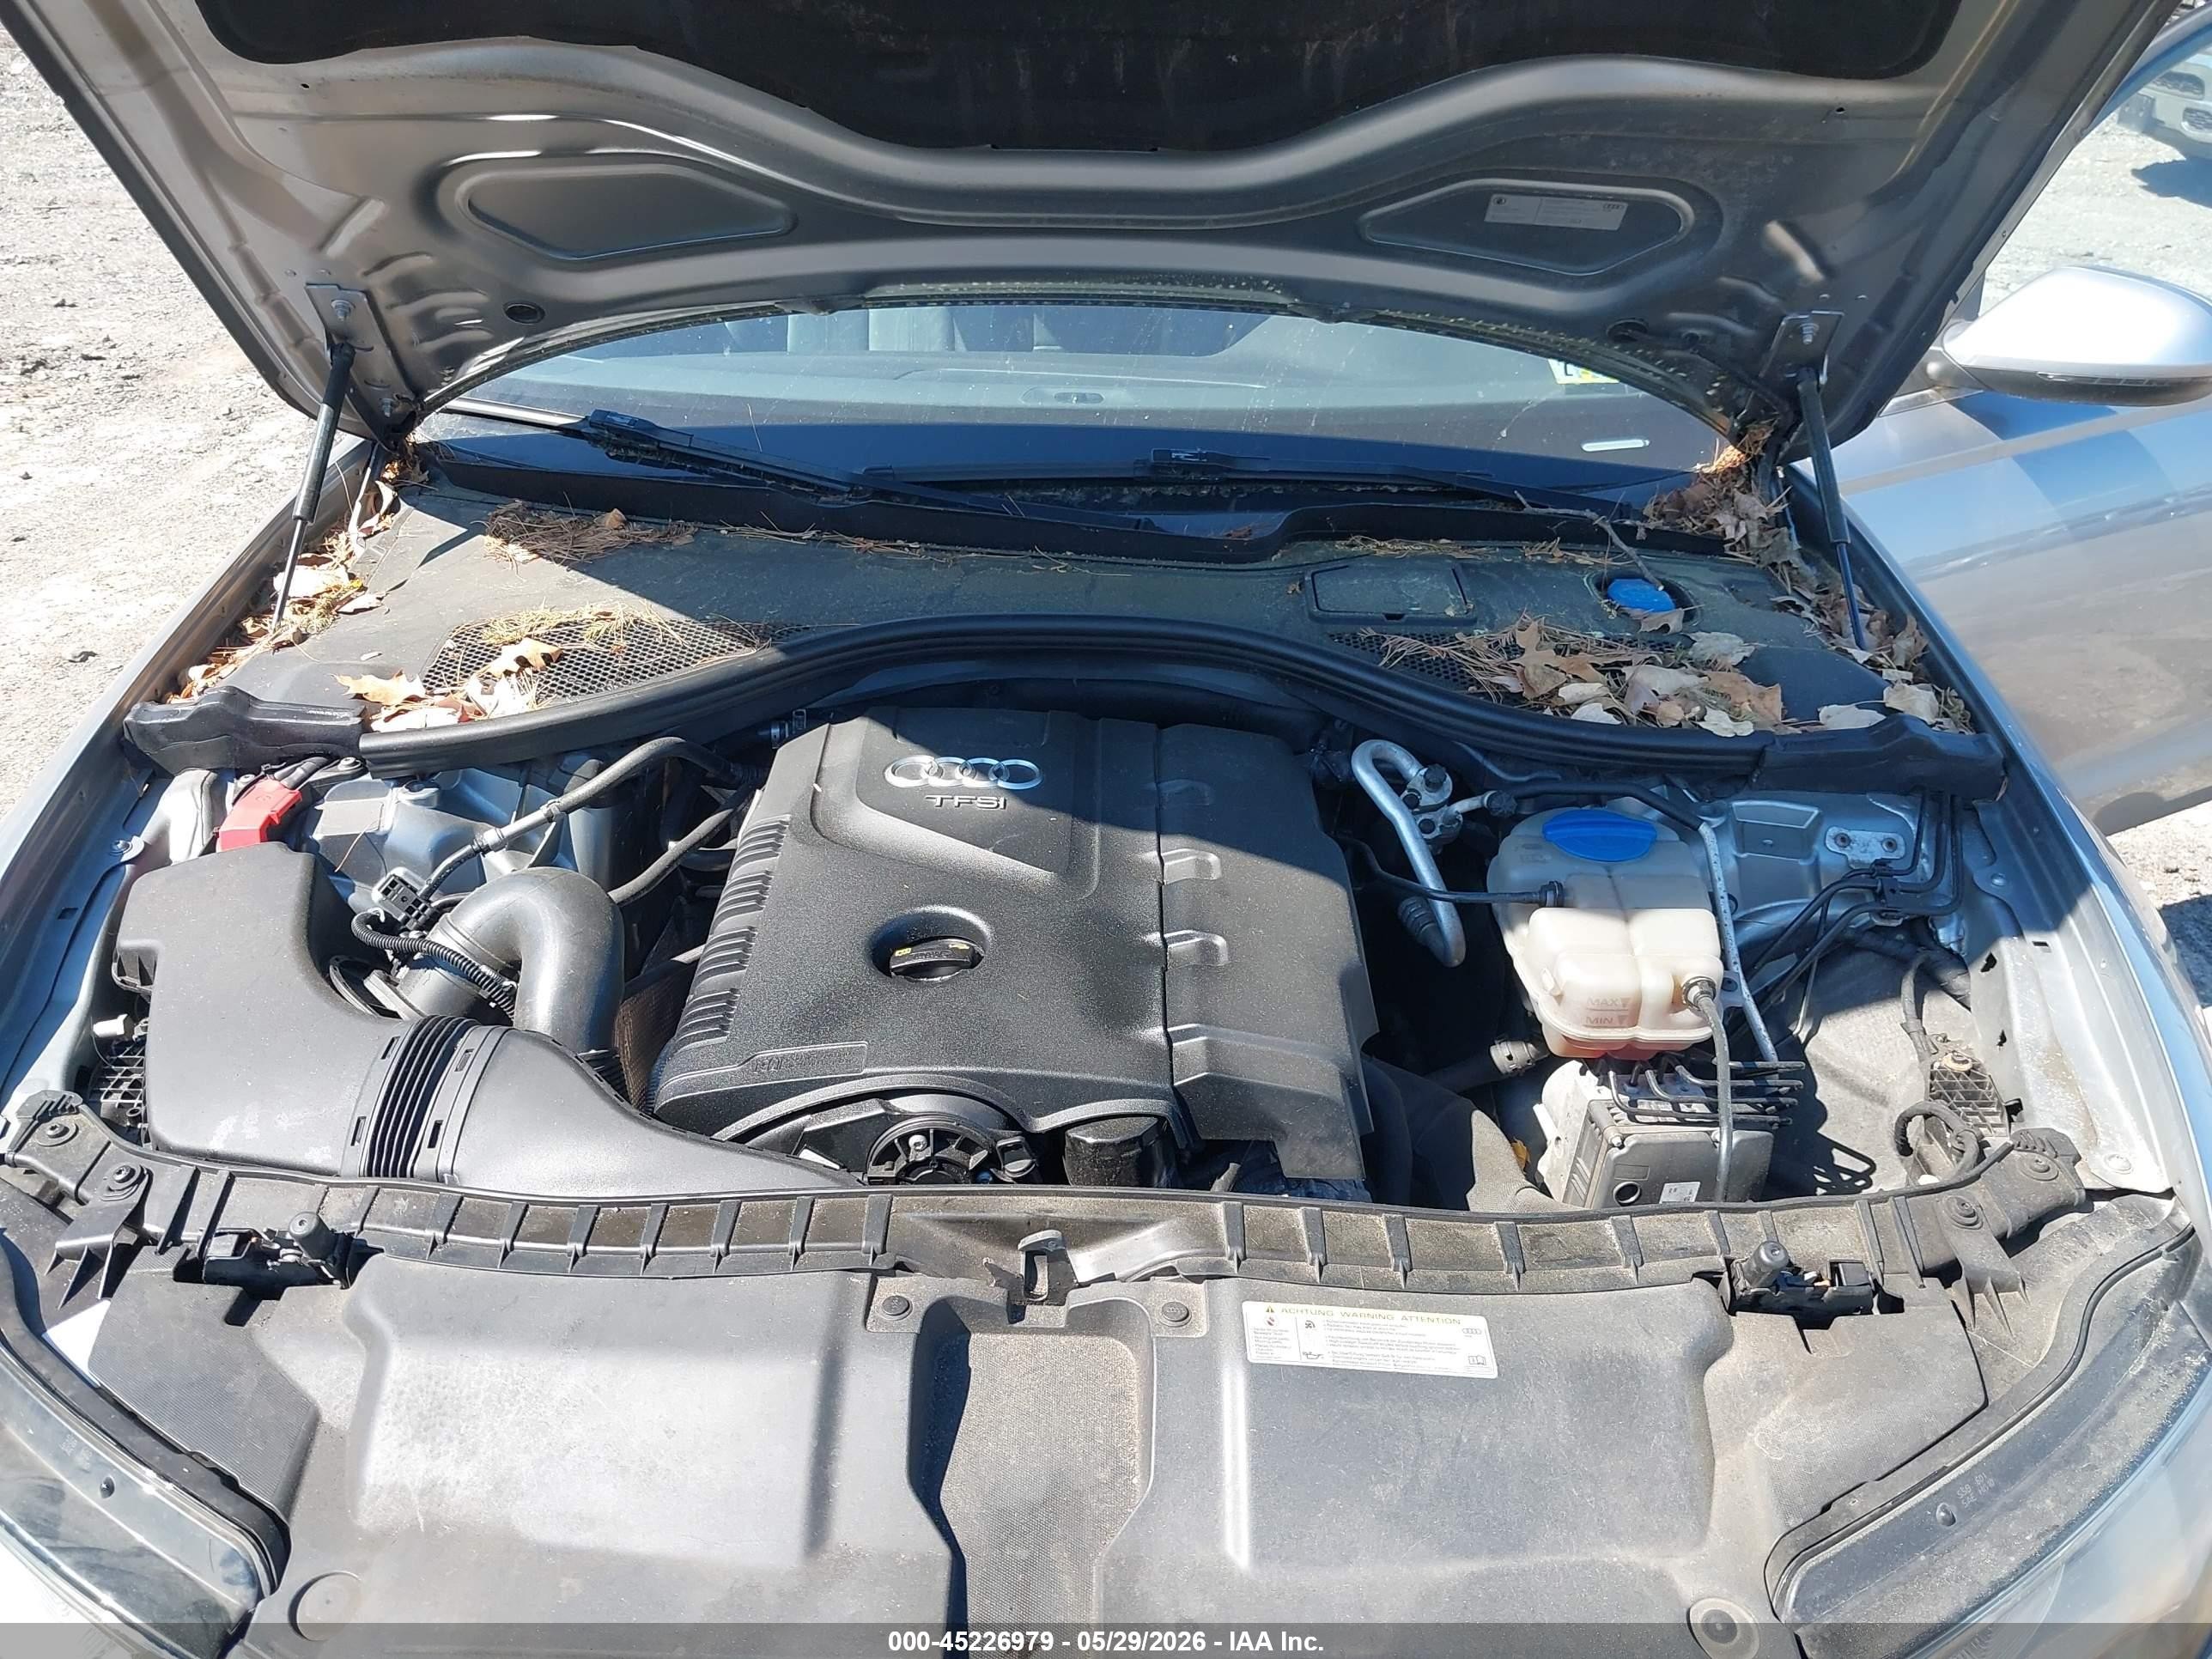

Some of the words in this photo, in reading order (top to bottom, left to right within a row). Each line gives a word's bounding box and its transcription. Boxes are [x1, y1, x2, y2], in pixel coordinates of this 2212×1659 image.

[925, 794, 1007, 811] TFSI
[1586, 996, 1620, 1006] MAX
[1585, 1016, 1613, 1025] MIN
[1280, 1307, 1334, 1317] ACHTUNG
[1340, 1311, 1395, 1322] WARNING
[1401, 1316, 1462, 1326] ATTENTION
